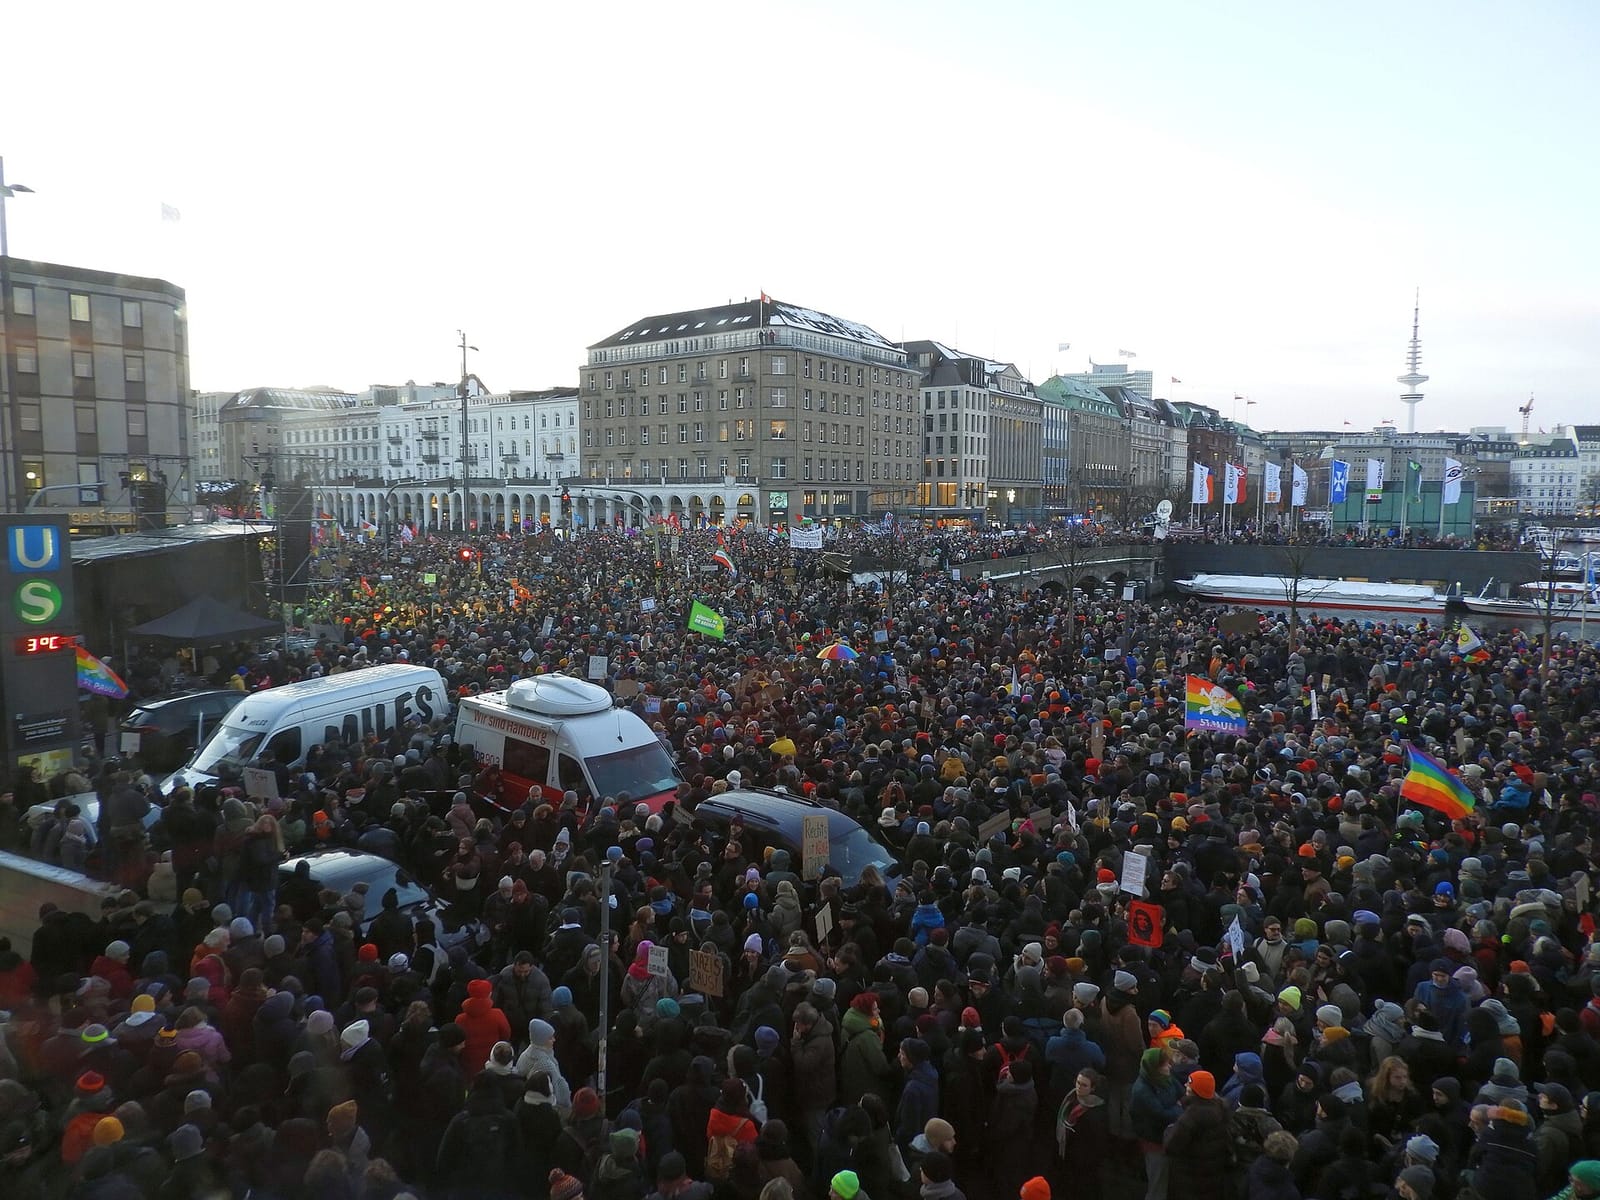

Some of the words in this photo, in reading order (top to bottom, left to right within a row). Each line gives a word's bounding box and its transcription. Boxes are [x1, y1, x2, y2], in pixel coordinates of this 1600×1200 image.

[15, 528, 53, 568] U
[20, 582, 55, 621] S
[325, 685, 433, 744] MILES
[474, 709, 488, 723] Wir
[488, 715, 506, 729] sind
[507, 720, 548, 745] Hamburg
[691, 950, 721, 976] NAZIS
